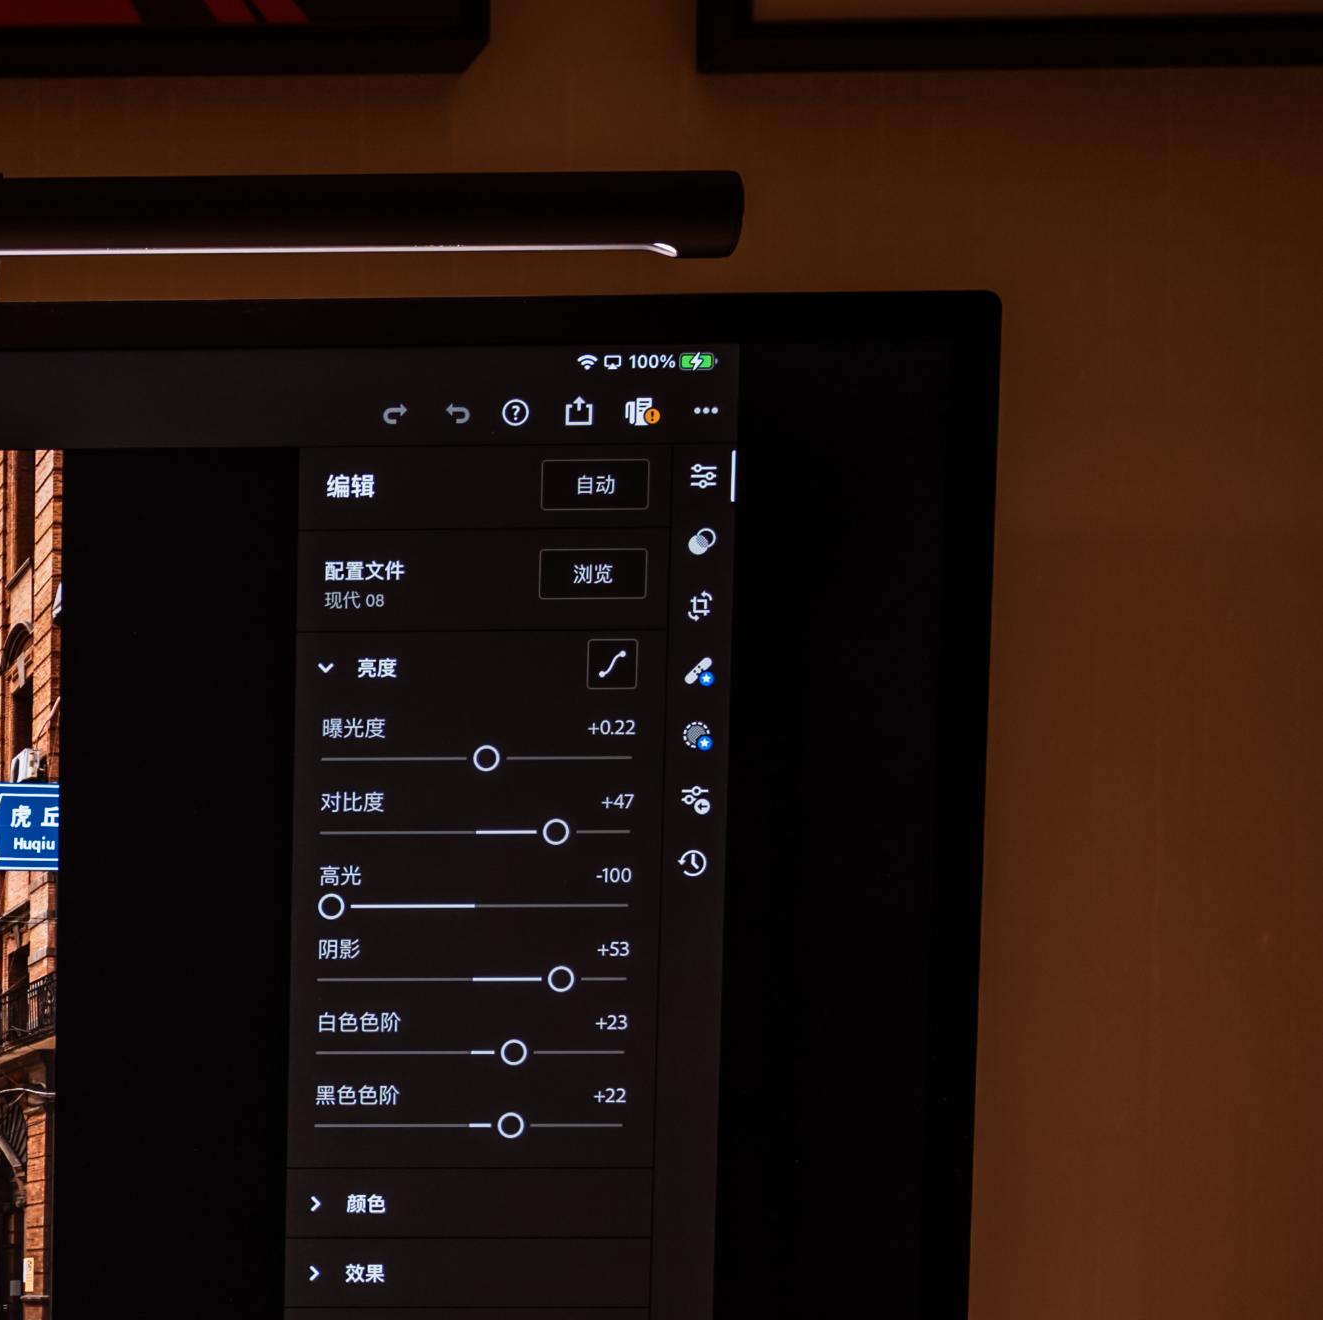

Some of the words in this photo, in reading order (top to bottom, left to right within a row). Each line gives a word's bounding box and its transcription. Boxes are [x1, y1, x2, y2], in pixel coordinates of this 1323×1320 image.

[629, 355, 675, 370] 100%
[326, 474, 375, 498] 编辑
[577, 475, 615, 495] 自动
[324, 561, 405, 582] 配置文件
[573, 564, 613, 585] 浏览
[324, 591, 361, 609] 现代
[366, 594, 385, 608] 08
[357, 658, 397, 678] 亮度
[322, 718, 386, 739] 曝光度
[588, 720, 636, 735] +0.22
[321, 792, 384, 813] 对比度
[602, 793, 634, 809] +47
[13, 838, 55, 852] Huqiu
[320, 865, 361, 886] 高光
[596, 868, 632, 883] -100
[317, 938, 361, 960] 阴影
[597, 941, 630, 957] +53
[317, 1011, 401, 1033] 白色色阶
[595, 1014, 628, 1031] +23
[315, 1084, 400, 1106] 黑色色阶
[594, 1088, 626, 1104] +22
[346, 1194, 386, 1214] 颜色
[345, 1264, 385, 1283] 效果
